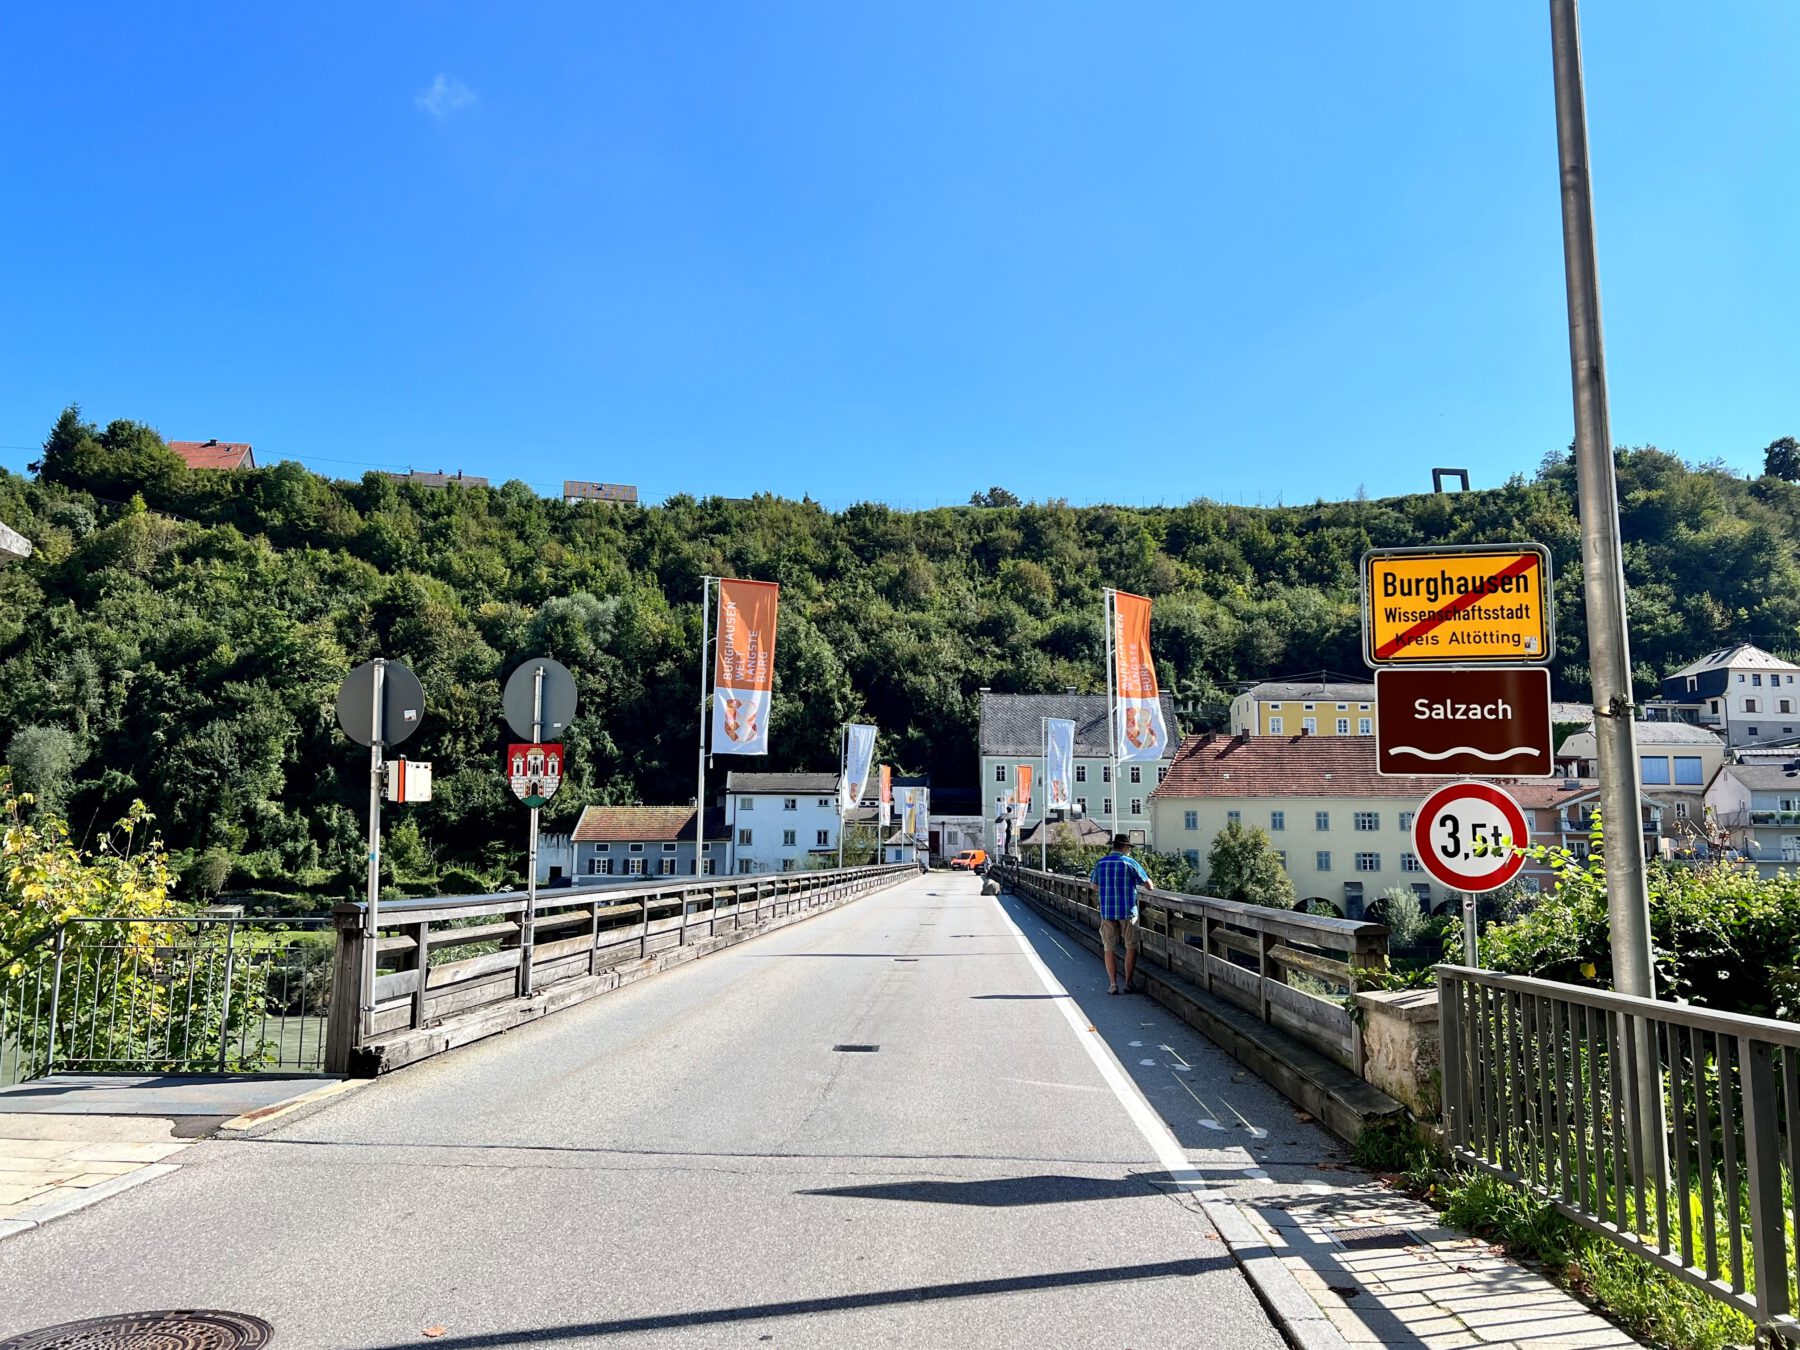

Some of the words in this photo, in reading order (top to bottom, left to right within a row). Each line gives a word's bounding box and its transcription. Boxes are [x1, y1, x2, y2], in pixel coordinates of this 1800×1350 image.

[1384, 570, 1529, 602] Burghausen
[1384, 604, 1530, 622] Wissenschaftsstadt
[722, 601, 737, 680] BURGHAUSEN
[1395, 632, 1439, 646] Kreis
[1448, 630, 1521, 647] Altötting
[735, 651, 745, 681] WELT
[756, 651, 768, 683] BURG
[1414, 699, 1512, 720] Salzach
